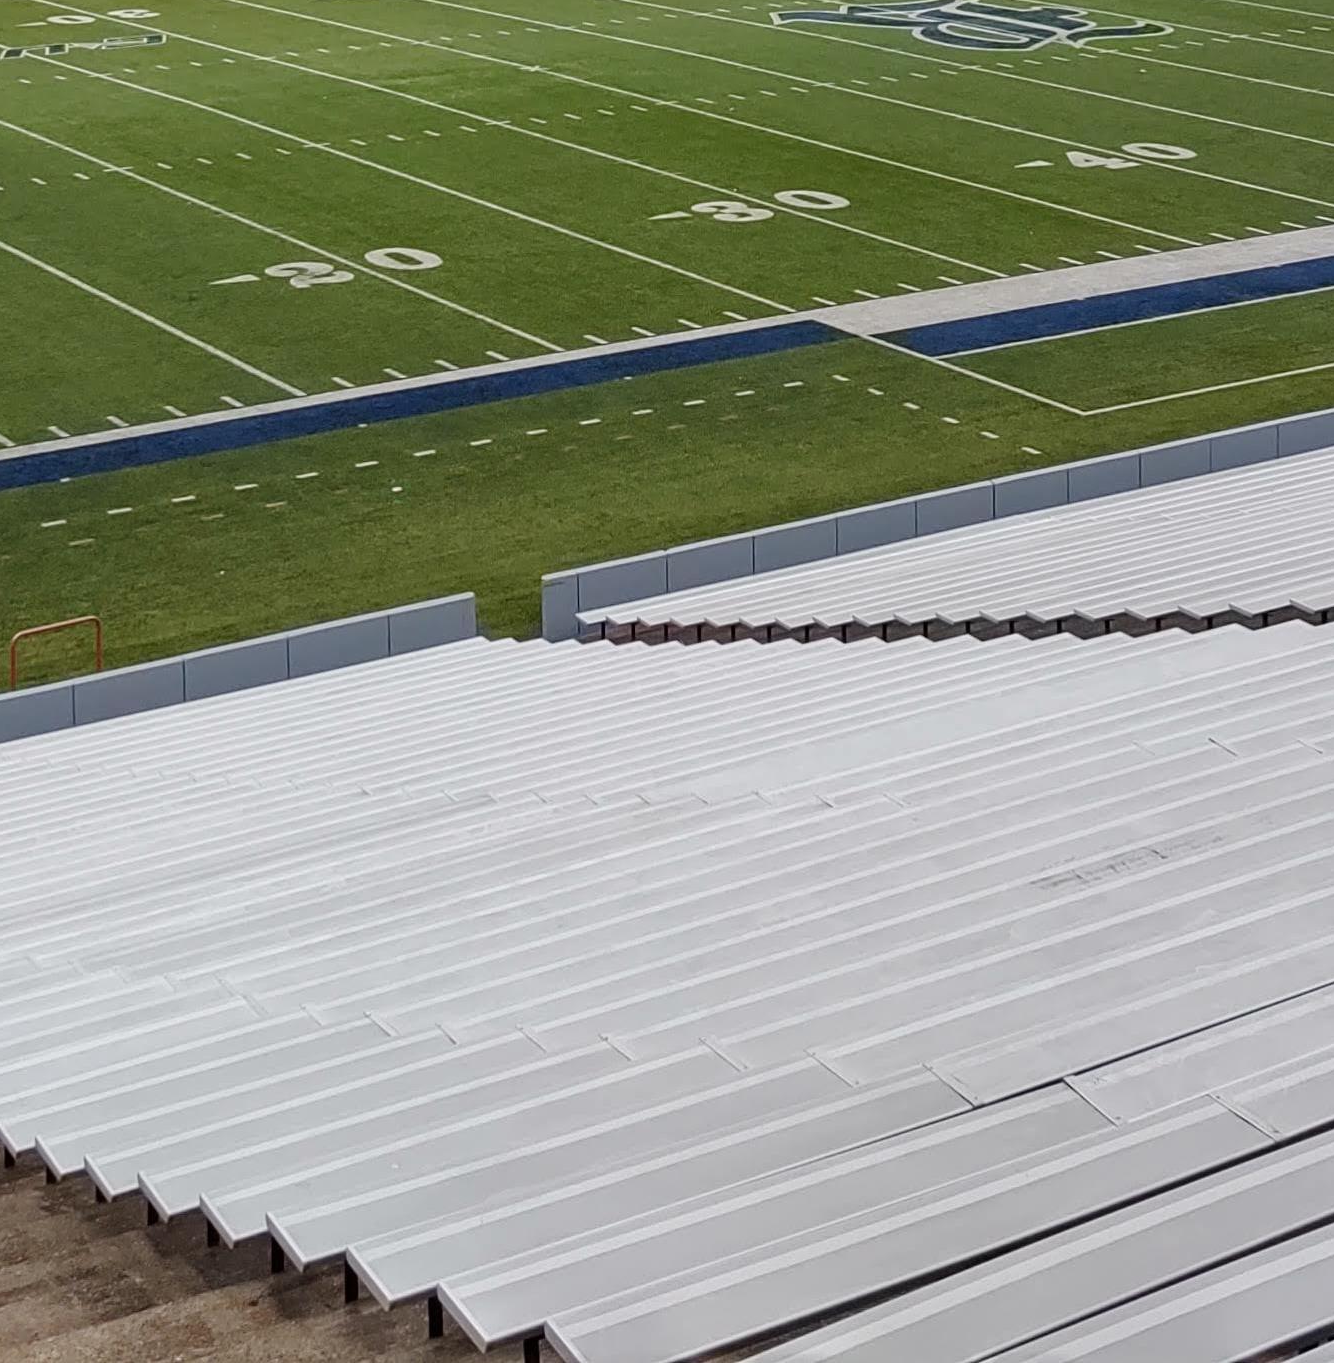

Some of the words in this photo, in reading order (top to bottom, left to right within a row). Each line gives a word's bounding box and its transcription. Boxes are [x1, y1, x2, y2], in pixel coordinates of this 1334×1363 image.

[1066, 142, 1198, 170] 40
[690, 189, 851, 222] 30
[265, 247, 444, 289] 20
